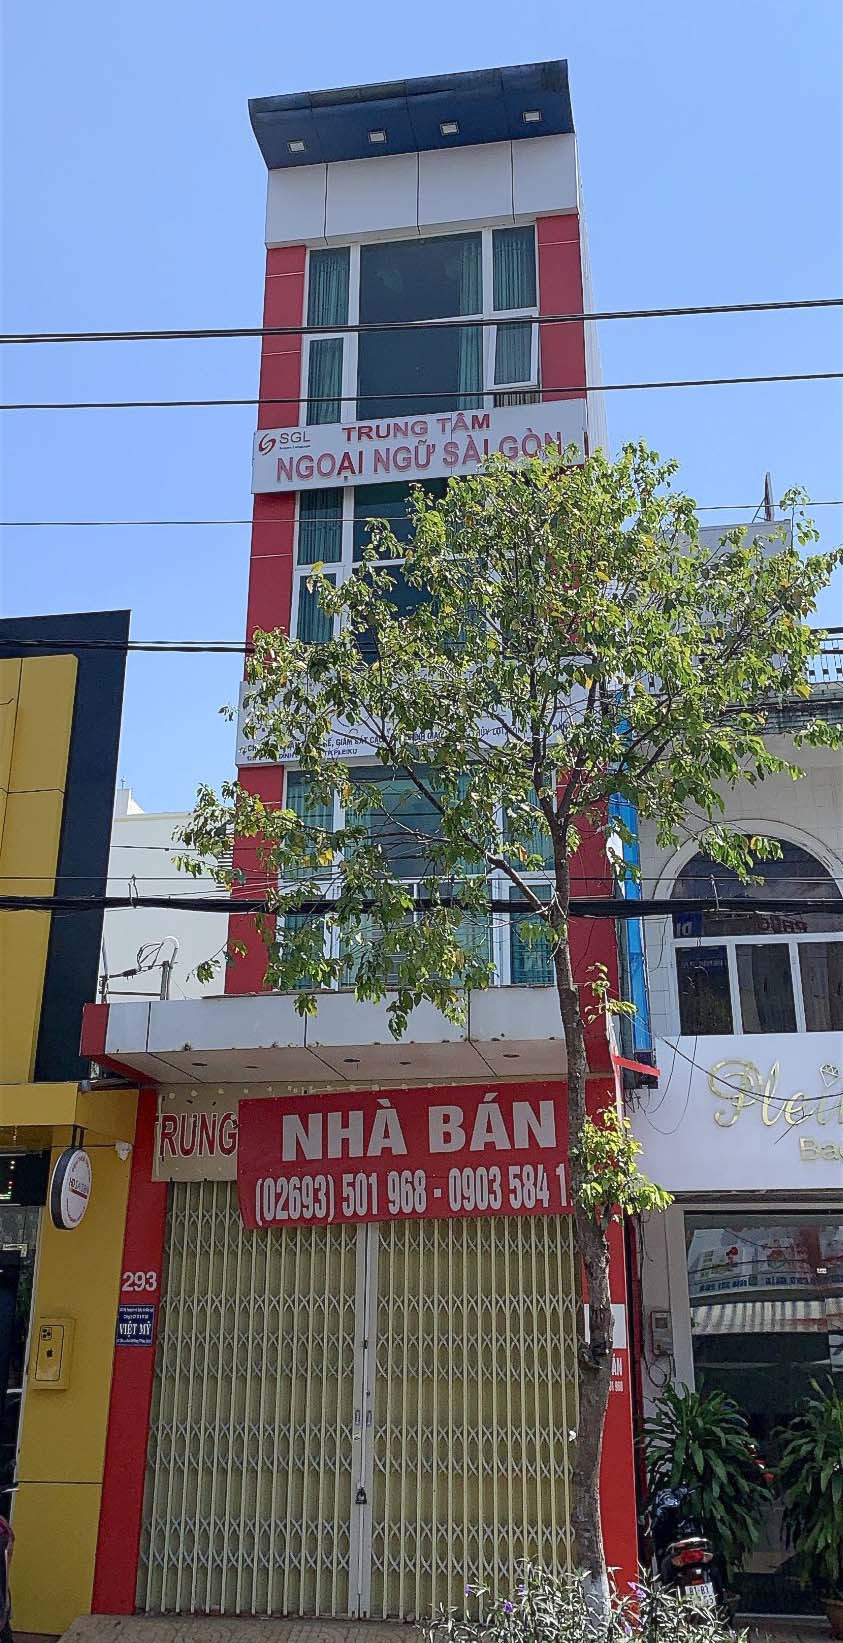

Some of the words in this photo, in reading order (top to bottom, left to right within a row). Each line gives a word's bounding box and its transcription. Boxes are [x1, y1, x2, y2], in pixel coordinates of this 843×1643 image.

[279, 431, 311, 444] SGL
[342, 419, 428, 442] TRUNG
[436, 412, 490, 434] TÂM
[276, 450, 364, 482] NGOẠI
[373, 438, 436, 473] NGỮ
[442, 434, 490, 467] SÀI
[281, 1098, 409, 1162] NHÀ
[428, 1091, 557, 1154] BÁN
[255, 1174, 335, 1227] (02693)
[342, 1171, 378, 1217] 501
[387, 1168, 428, 1214] 968
[448, 1166, 502, 1211] 0903
[508, 1164, 550, 1209] 584
[121, 1271, 157, 1291] 293
[611, 1353, 622, 1376] ÁN
